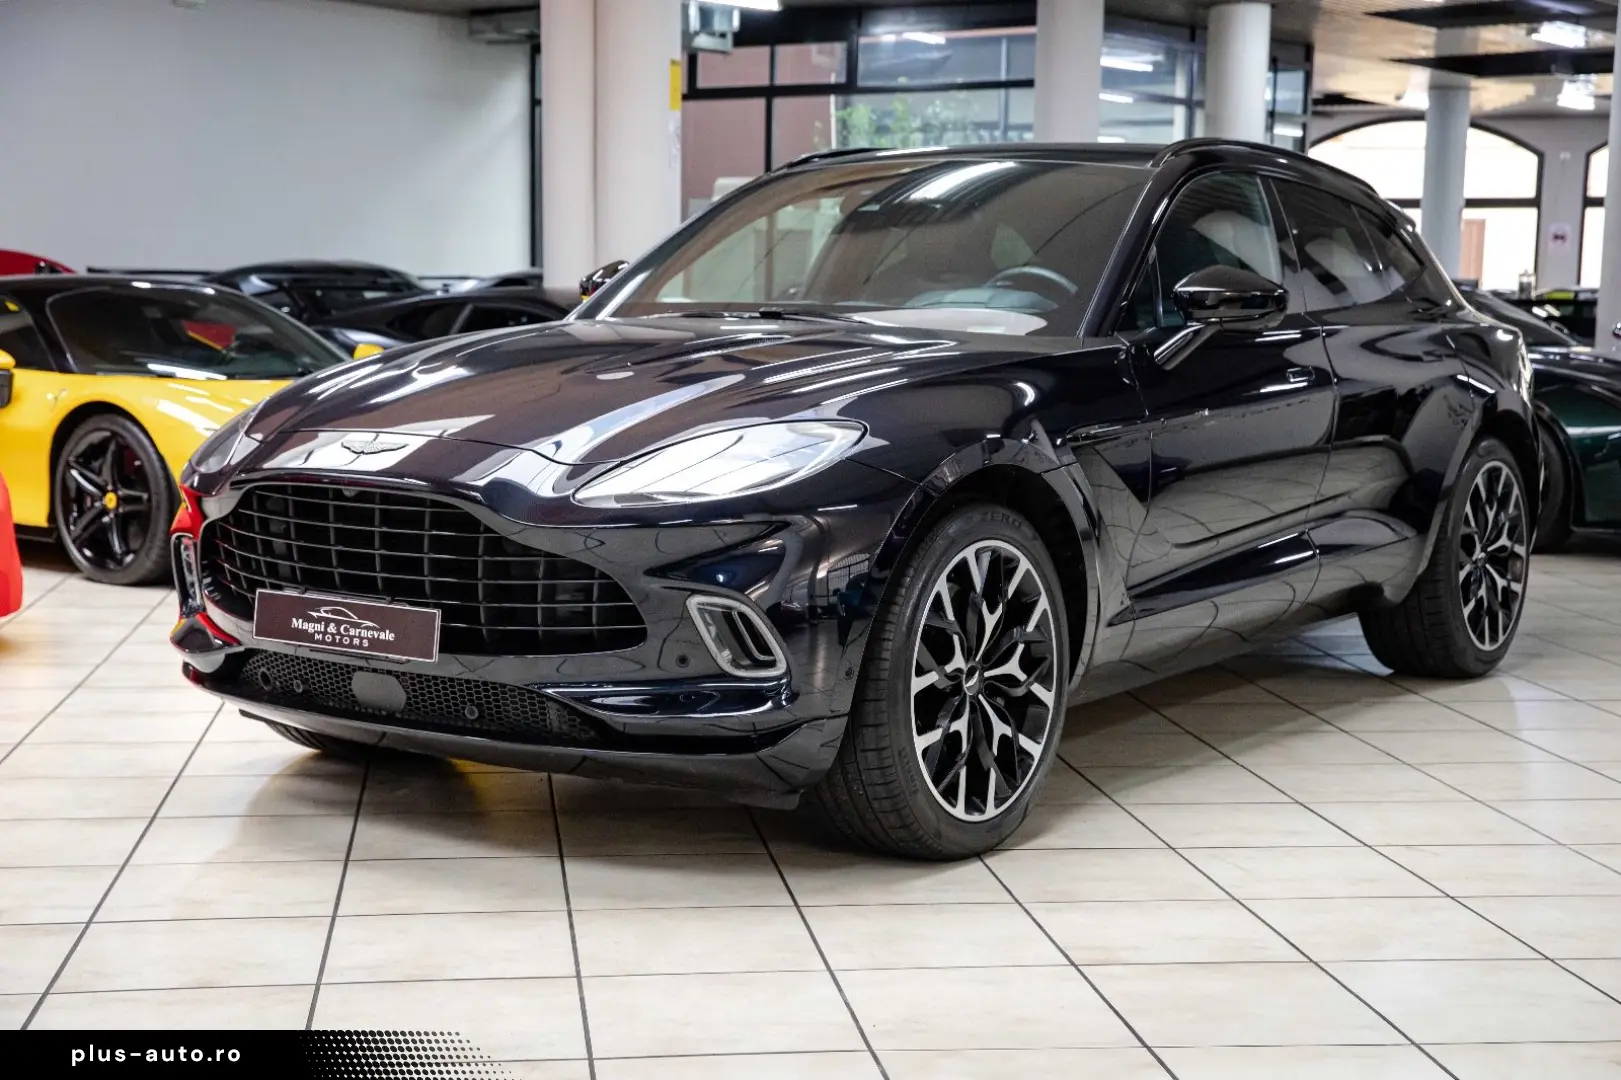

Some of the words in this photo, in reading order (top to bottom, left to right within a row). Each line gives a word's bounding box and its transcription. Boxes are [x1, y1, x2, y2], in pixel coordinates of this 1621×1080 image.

[291, 617, 325, 633] Magni
[326, 622, 337, 634] &
[340, 624, 395, 641] Carnevale
[314, 633, 369, 647] MOTORS
